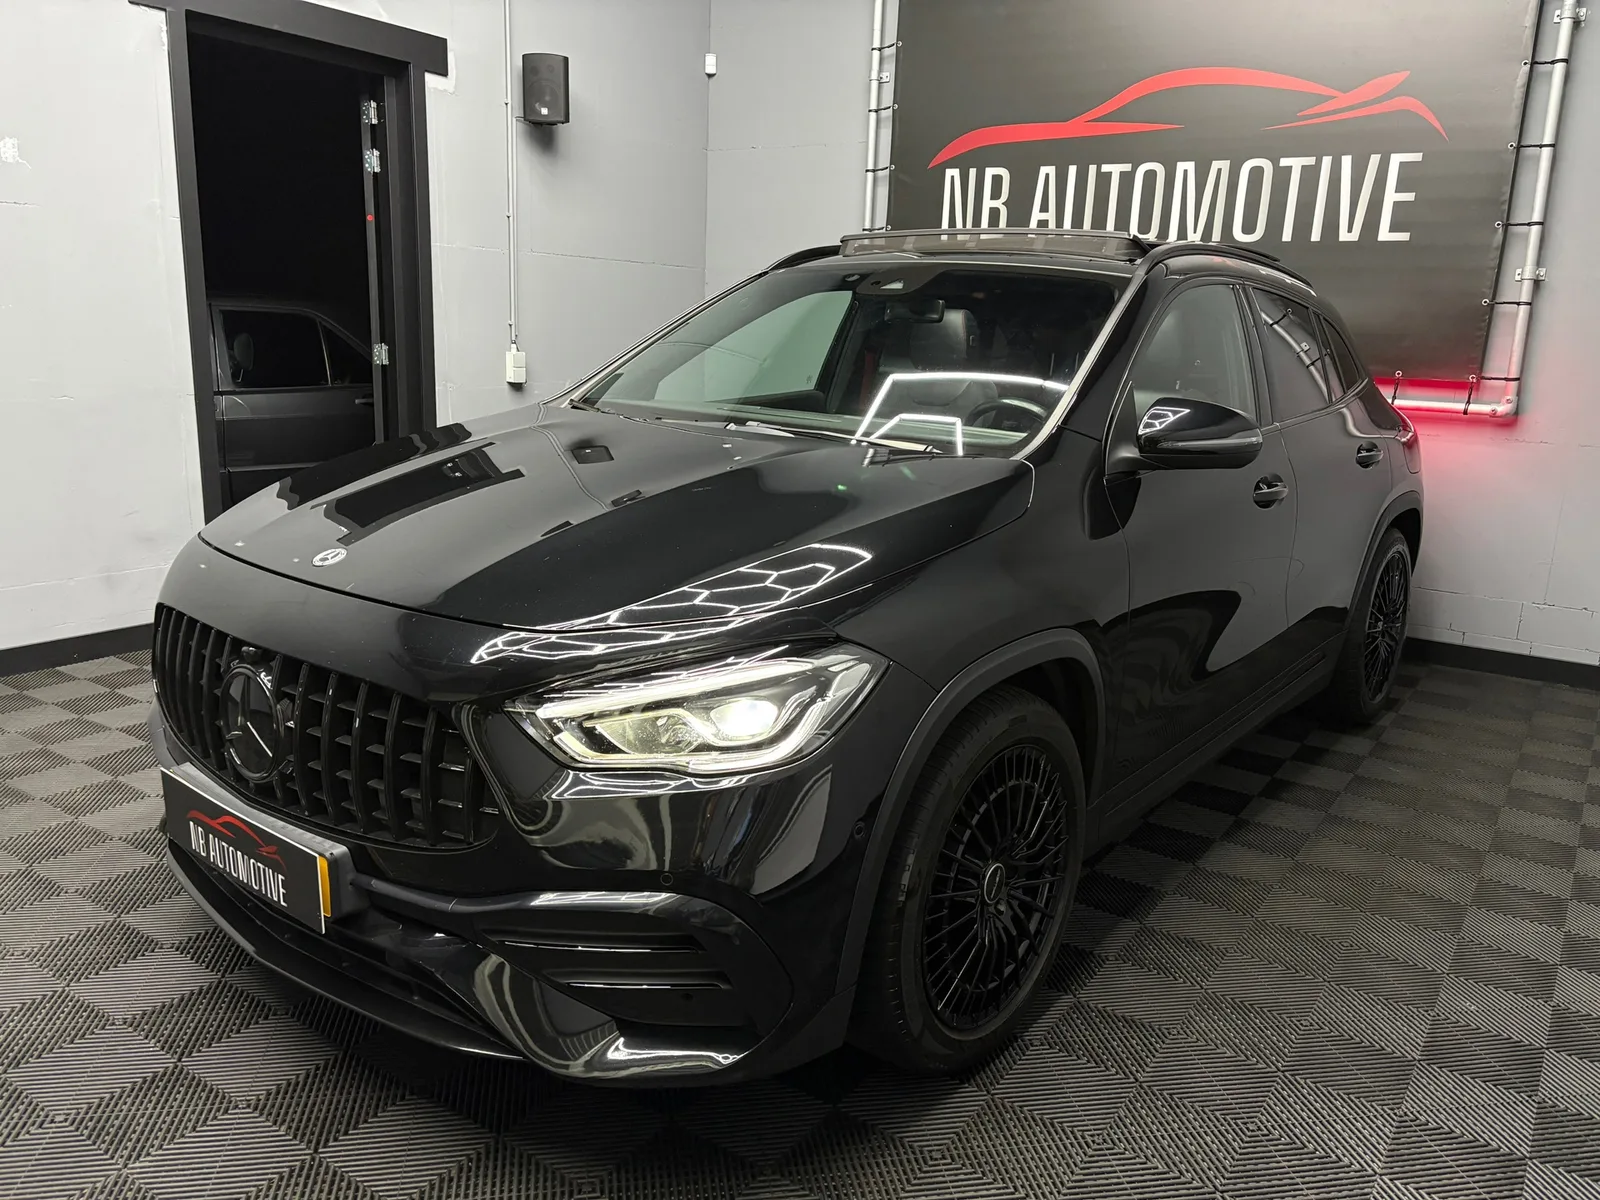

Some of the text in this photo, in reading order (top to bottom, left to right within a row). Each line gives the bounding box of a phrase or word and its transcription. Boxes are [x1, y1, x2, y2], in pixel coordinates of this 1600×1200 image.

[940, 152, 1423, 242] NB AUTOMOTIVE
[189, 820, 288, 908] NB AUTOMOTIVE
